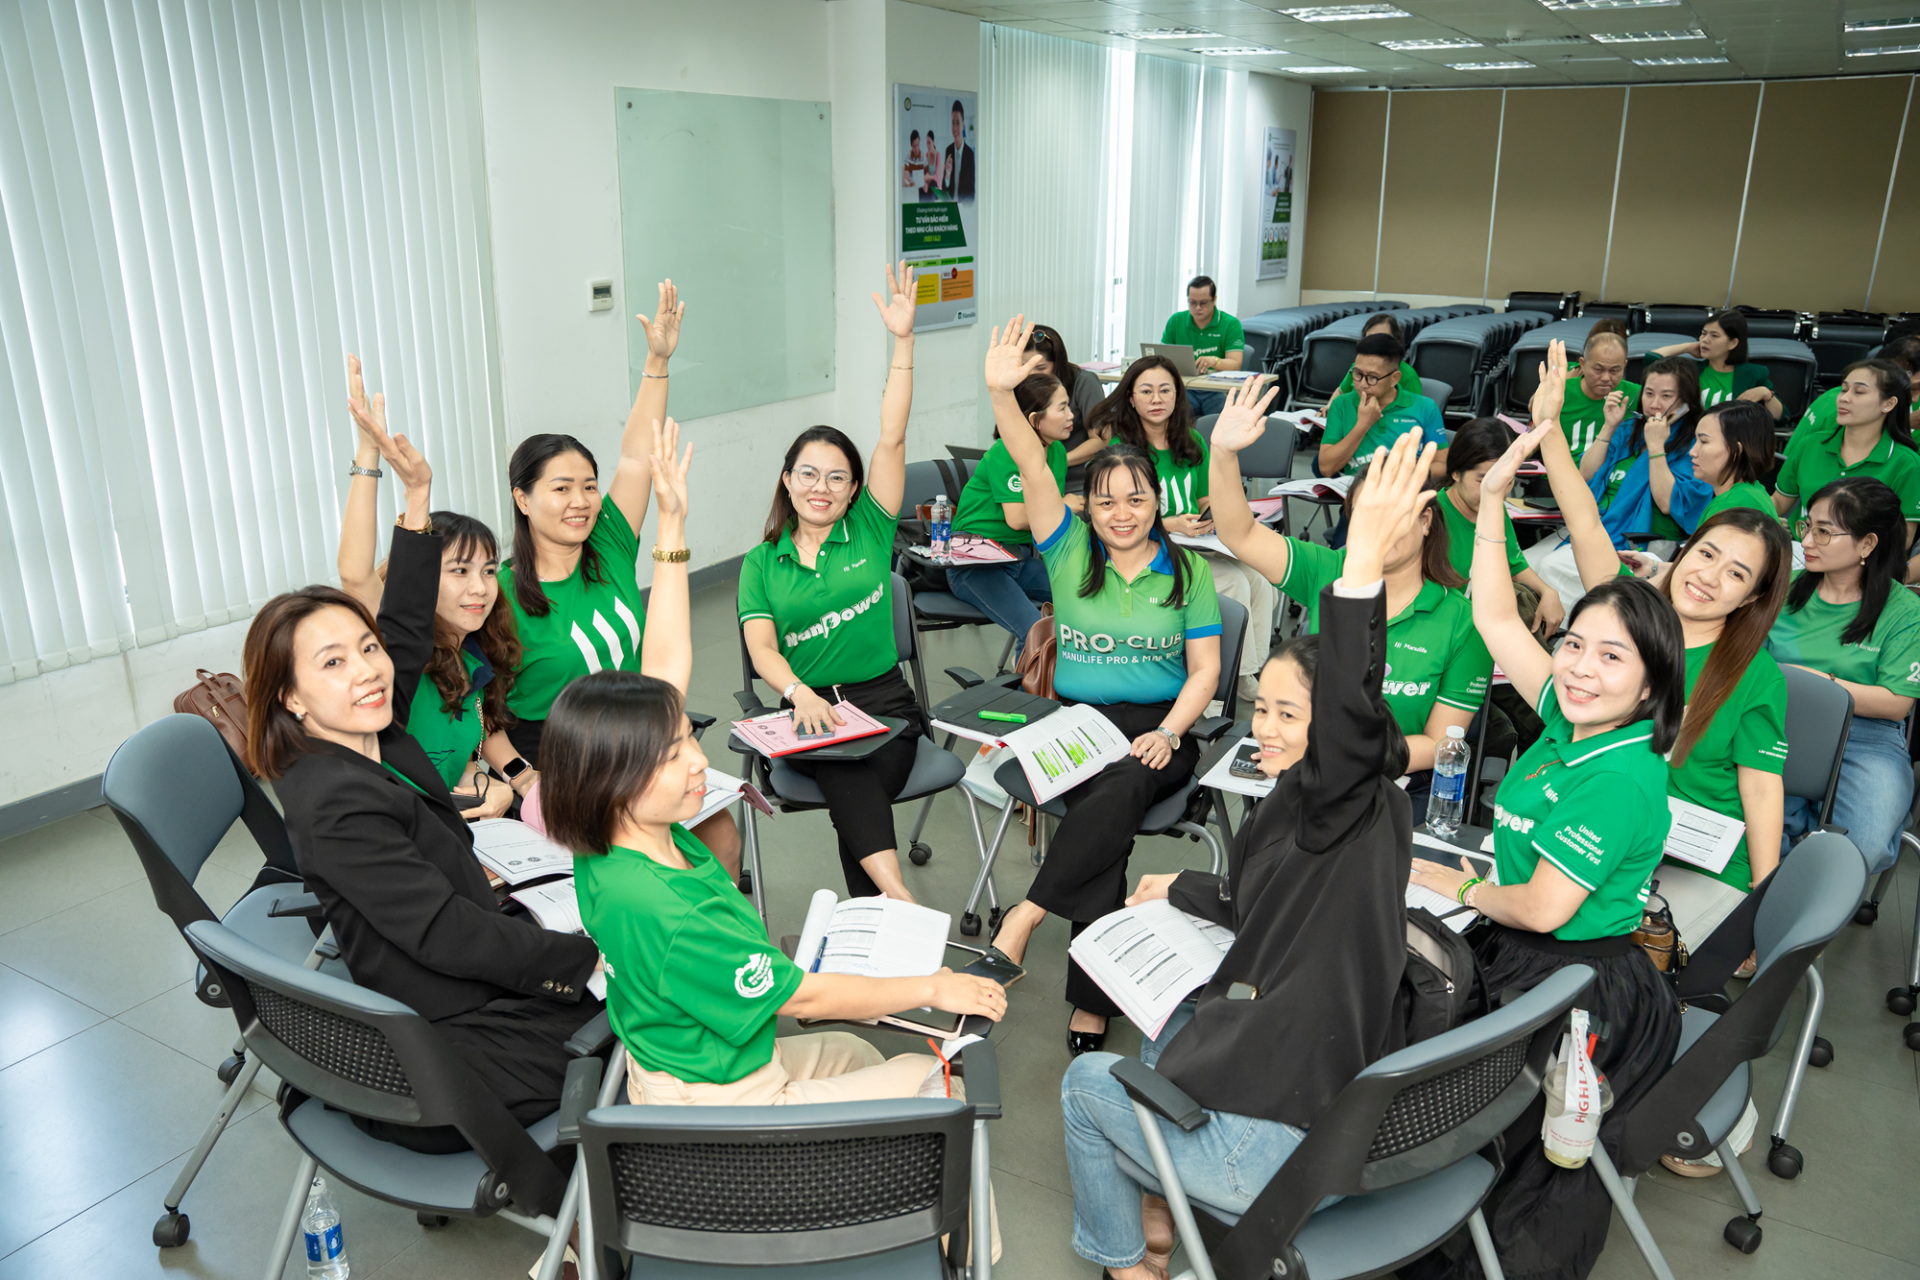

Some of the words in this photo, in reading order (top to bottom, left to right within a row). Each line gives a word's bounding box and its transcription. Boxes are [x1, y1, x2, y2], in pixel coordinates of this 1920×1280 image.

[1060, 623, 1182, 655] PRO-CLUB
[1403, 643, 1428, 654] Manulife
[1062, 650, 1103, 664] MANULIFE
[1106, 655, 1128, 664] PRO
[1131, 655, 1139, 663] &
[1563, 825, 1605, 856] Professional
[1578, 824, 1602, 843] United
[1554, 830, 1587, 856] Customer
[1585, 852, 1602, 866] First
